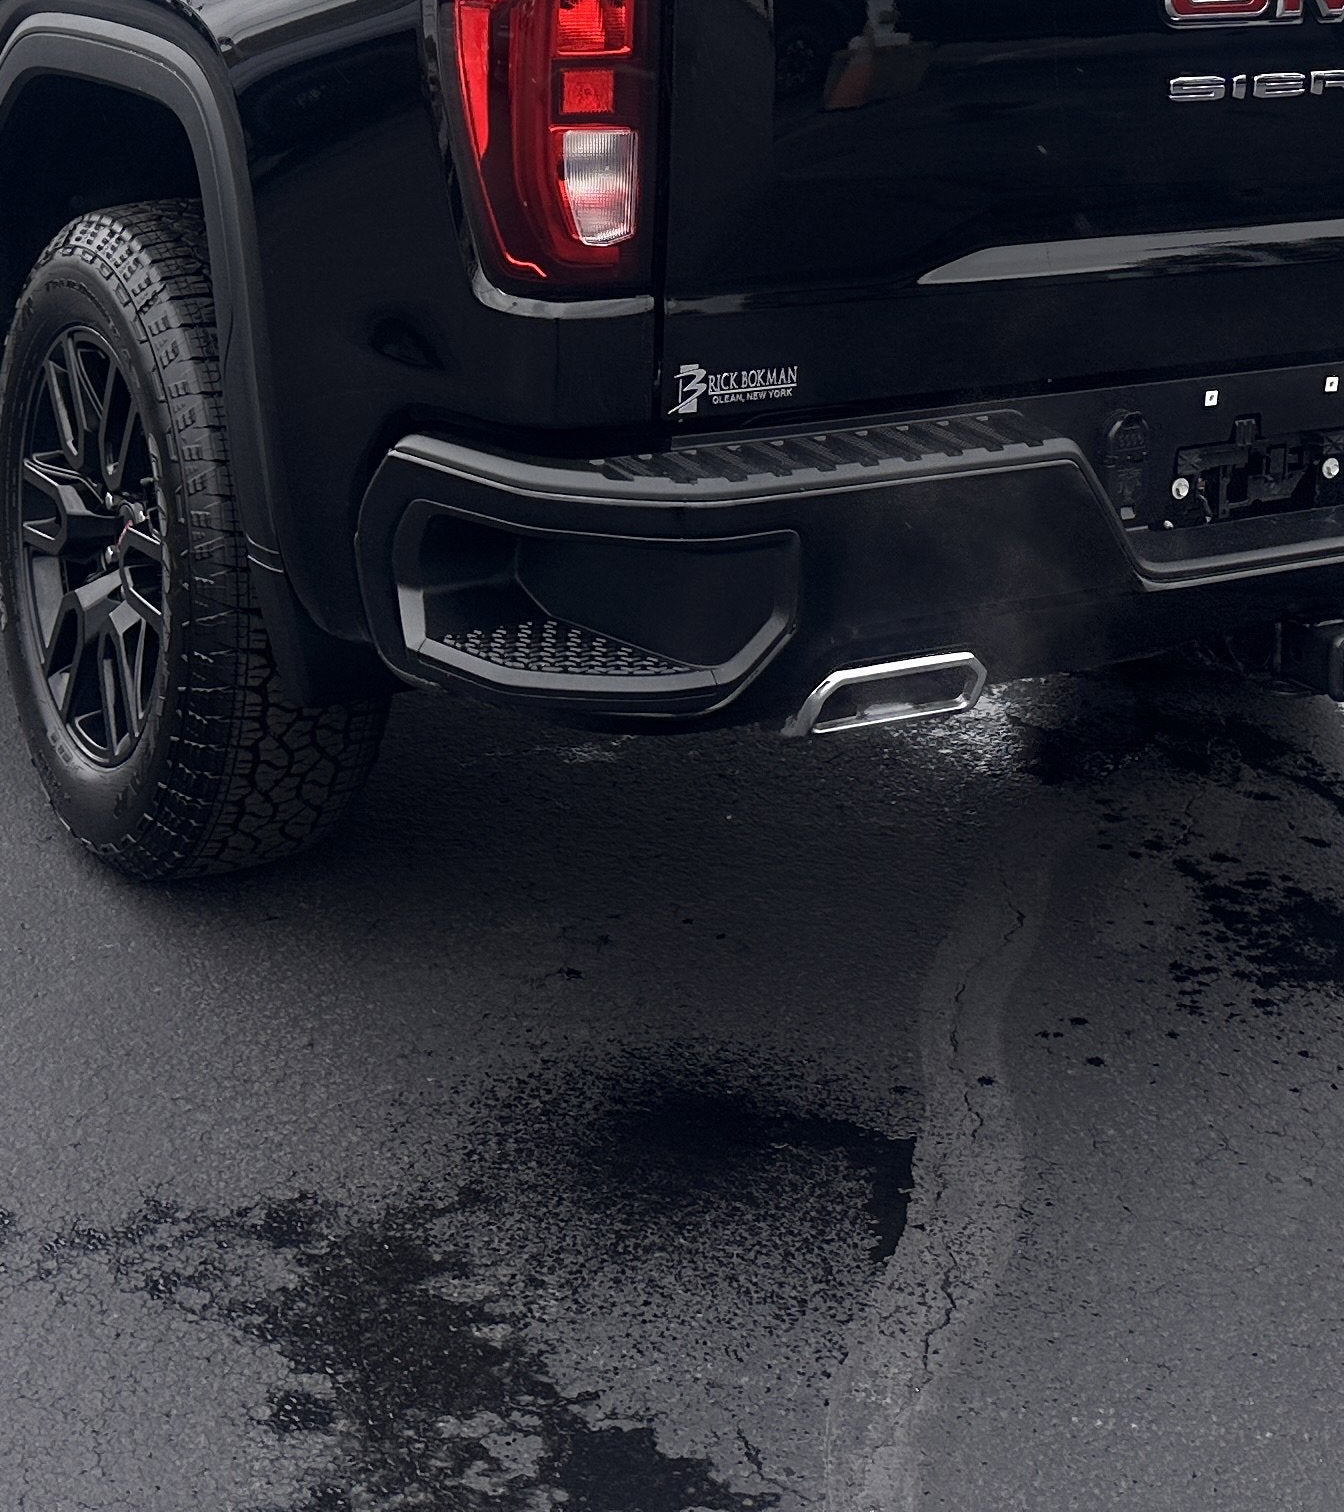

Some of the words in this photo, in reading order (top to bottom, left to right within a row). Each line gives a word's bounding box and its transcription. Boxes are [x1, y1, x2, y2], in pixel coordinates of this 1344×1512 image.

[742, 365, 798, 388] BOKMAN
[712, 393, 745, 405] OLEAN,
[746, 390, 767, 402] NEW
[768, 387, 793, 399] YORK
